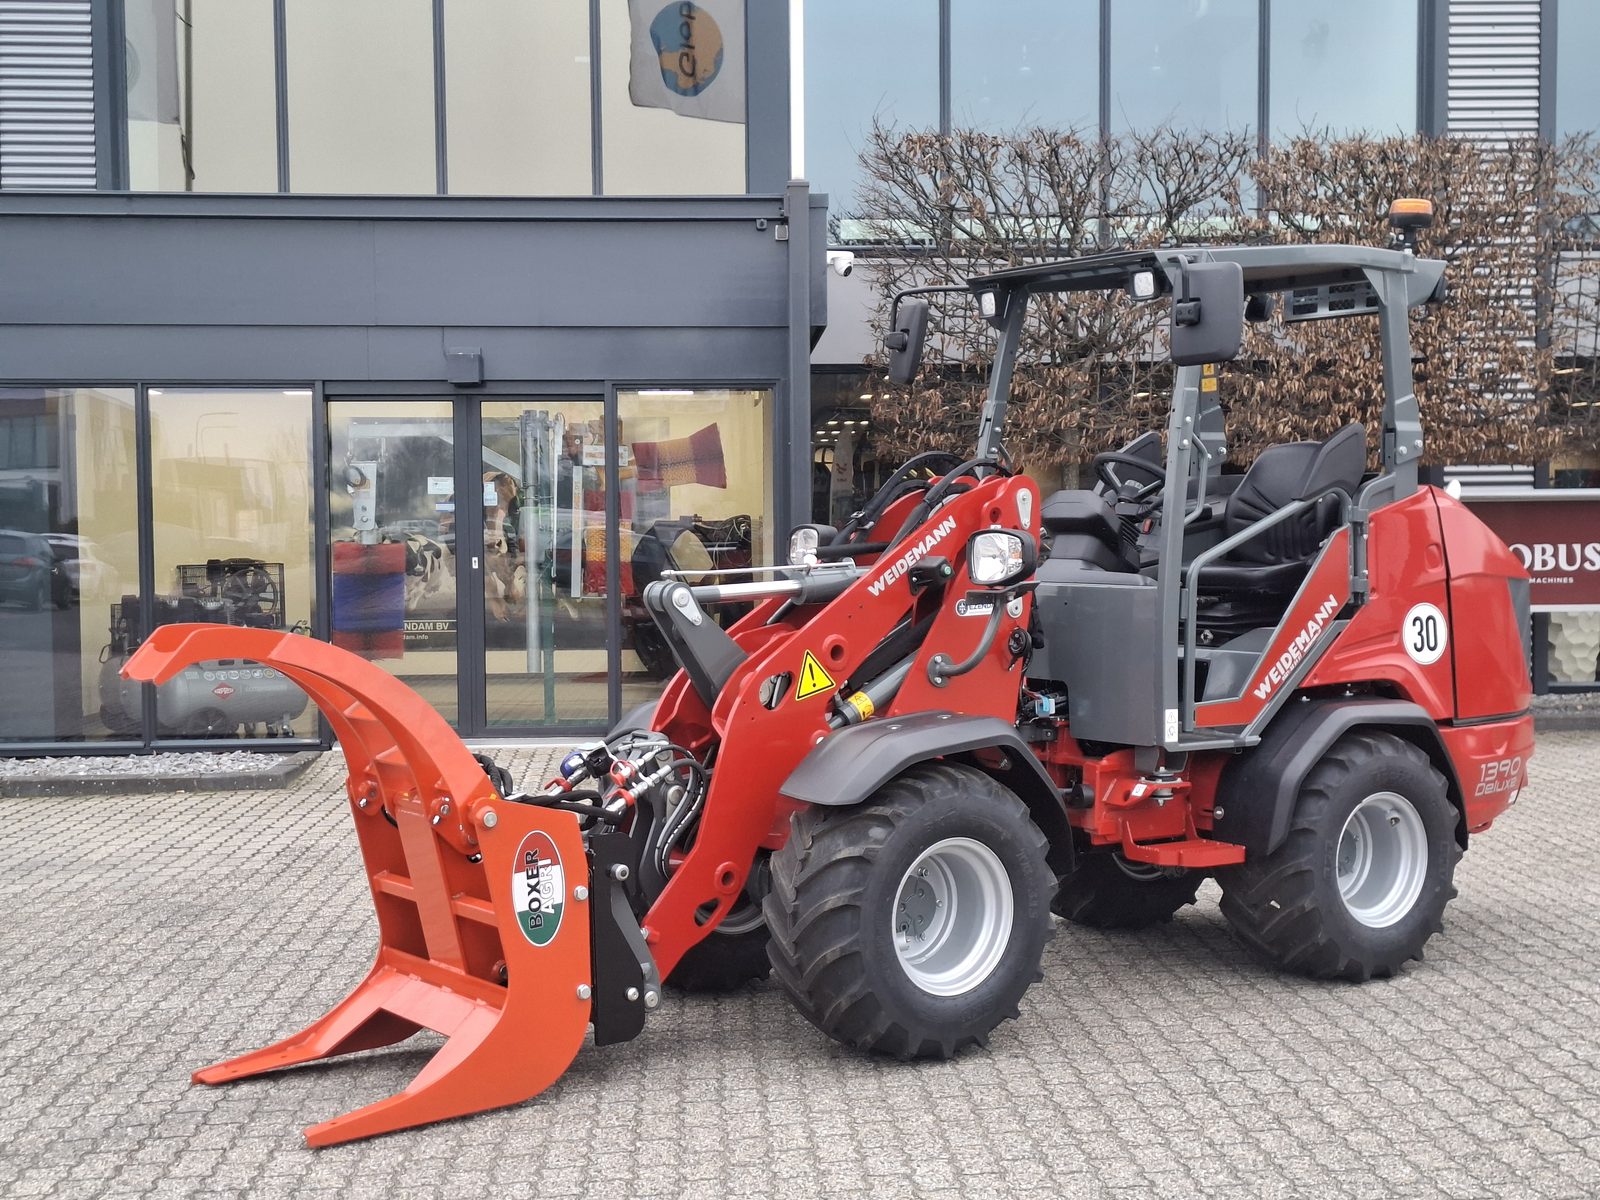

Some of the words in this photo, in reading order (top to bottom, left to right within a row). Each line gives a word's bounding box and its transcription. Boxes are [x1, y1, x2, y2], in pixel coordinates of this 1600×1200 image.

[867, 515, 956, 596] WEIDEMANN
[1508, 543, 1600, 571] OBUS
[404, 622, 434, 631] NDAM
[436, 622, 449, 631] BV
[1253, 594, 1338, 699] WEIDEMANN
[1412, 614, 1438, 652] 30
[1480, 756, 1521, 782] 1390
[525, 848, 543, 930] BOXER
[537, 858, 555, 914] AGRI
